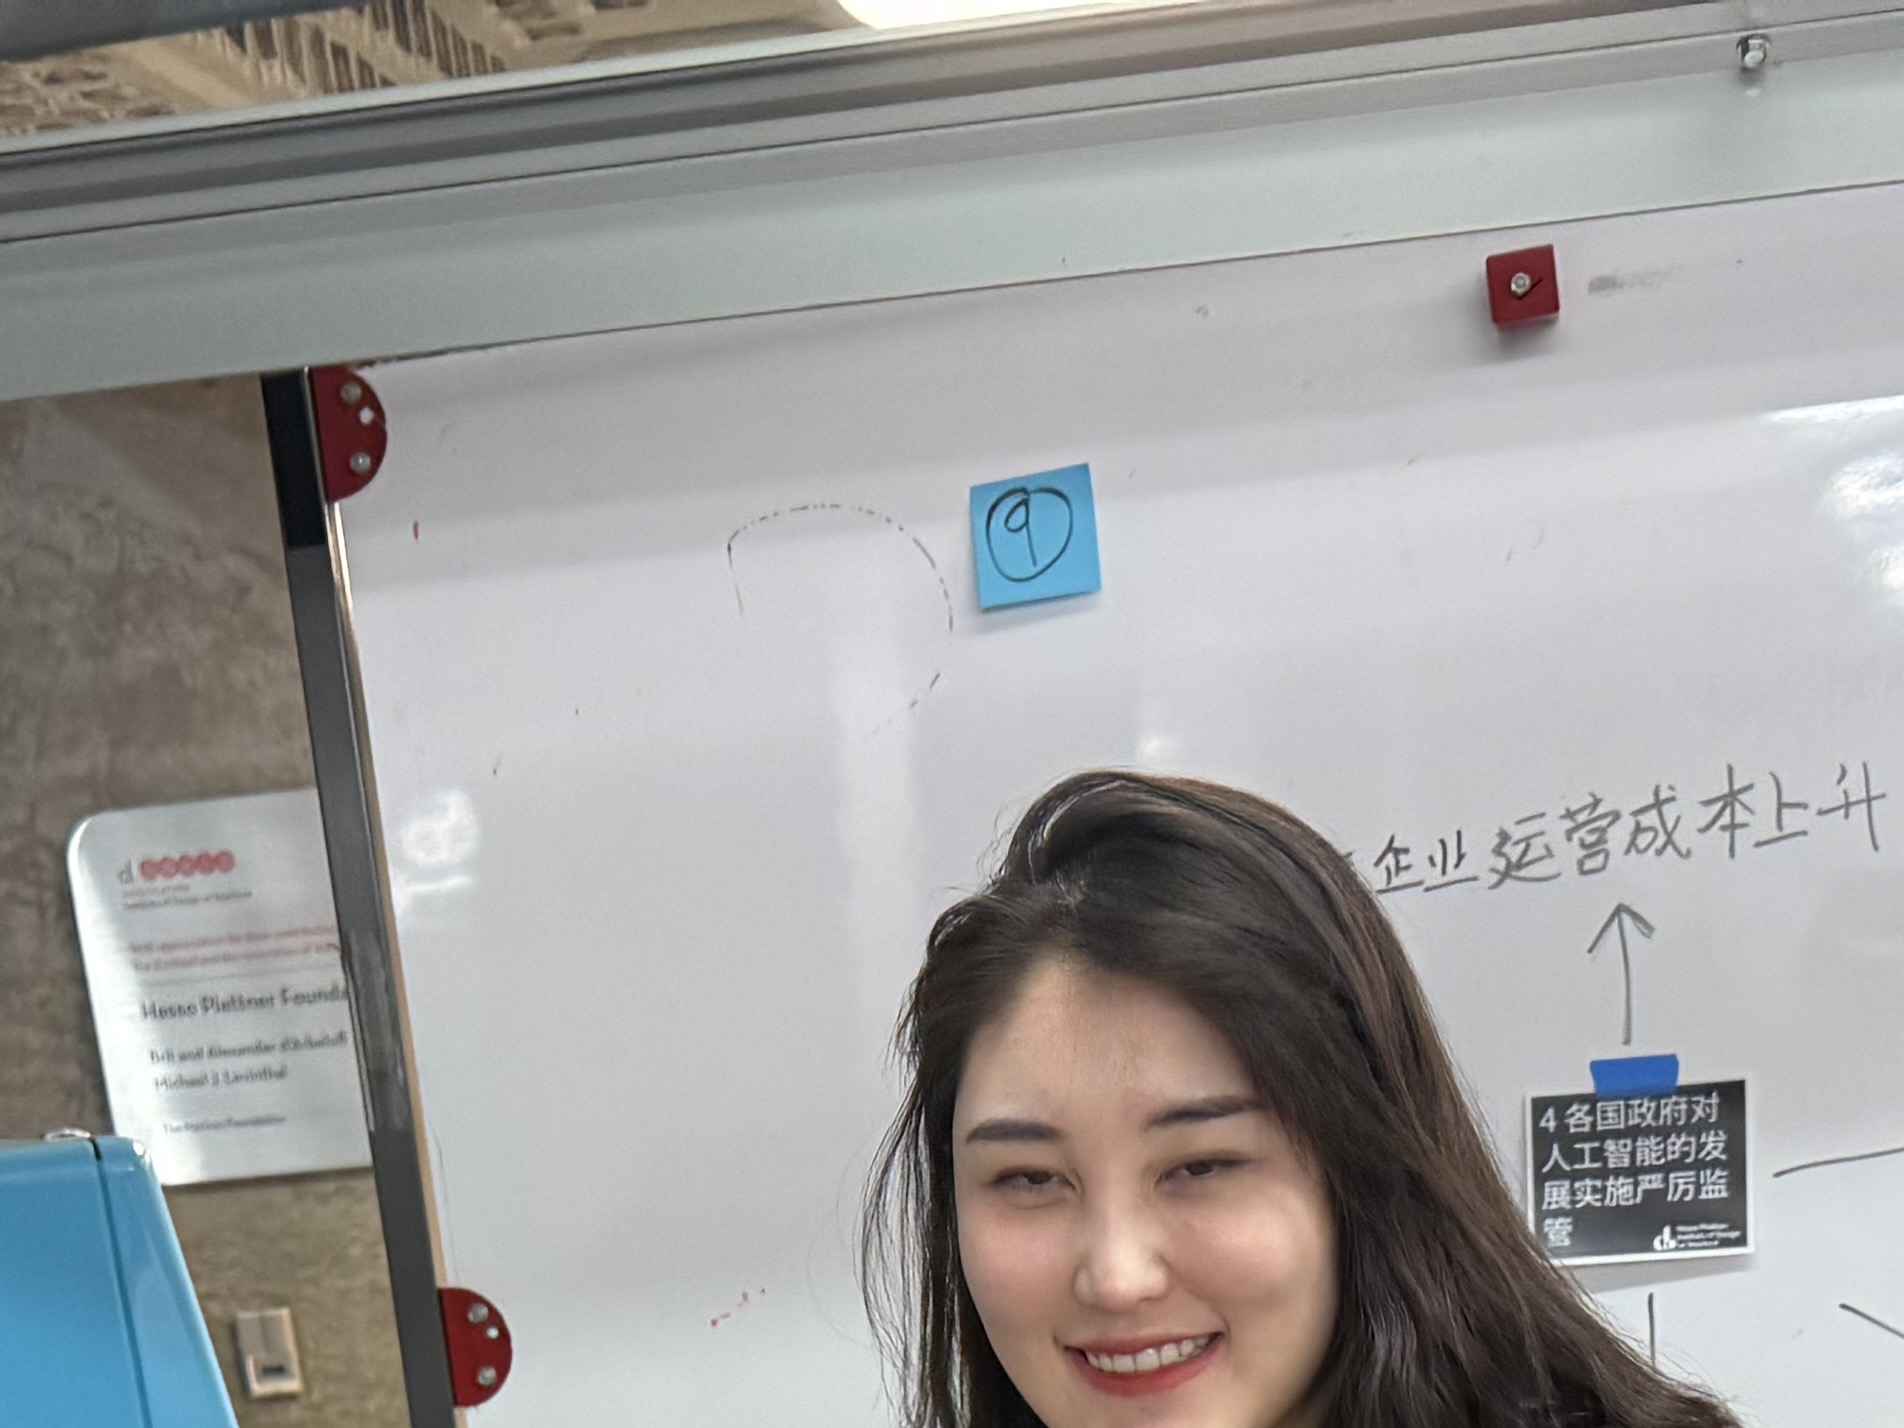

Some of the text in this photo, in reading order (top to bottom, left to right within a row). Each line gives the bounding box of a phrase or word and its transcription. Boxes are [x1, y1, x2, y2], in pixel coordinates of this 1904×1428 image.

[1539, 1089, 1721, 1134] 4 各国政府对
[1541, 1129, 1728, 1173] 人工智能的发
[1542, 1167, 1729, 1211] 展实施严厉监
[1543, 1216, 1573, 1247] 管
